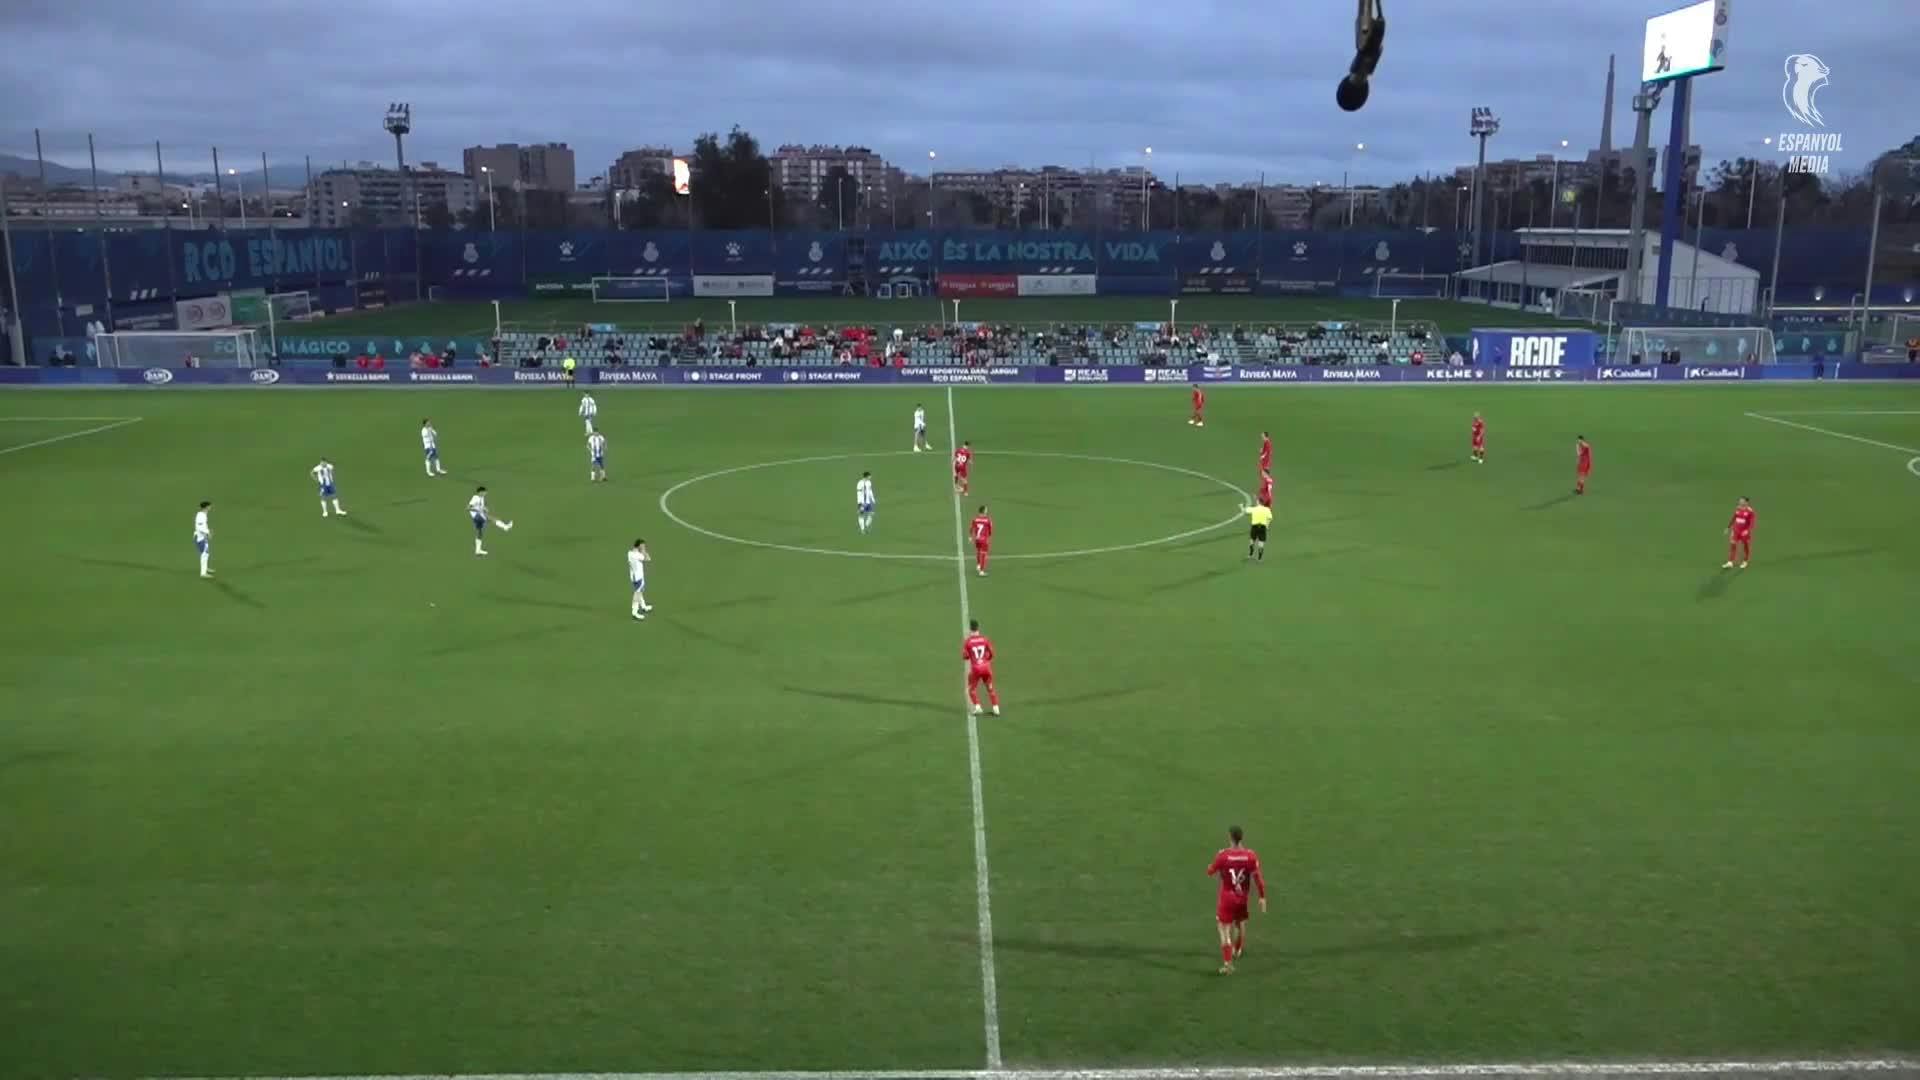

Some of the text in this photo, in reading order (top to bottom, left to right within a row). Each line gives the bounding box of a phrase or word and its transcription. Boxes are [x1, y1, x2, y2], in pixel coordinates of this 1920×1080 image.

[975, 243, 1001, 261] LA
[1008, 241, 1094, 261] NOSTRA
[1106, 242, 1160, 262] VIDA
[183, 237, 350, 282] RCD ESPANYOL
[514, 371, 568, 381] RIVIERA MAY
[600, 371, 658, 381] RIVIERA MAYA
[901, 367, 928, 375] CIUTAT
[929, 367, 969, 375] ESPORTIVA
[1239, 369, 1297, 379] RIVIERA MAYA
[1323, 368, 1381, 379] RIVIERA MAYA
[1426, 369, 1472, 378] KELME
[1506, 369, 1551, 378] KELME
[1613, 368, 1653, 378] CaixaBank
[1701, 368, 1739, 378] CaixaBank
[709, 372, 762, 381] STAGE FRONT
[808, 372, 861, 381] STAGE FRONT
[976, 523, 984, 539] 7
[971, 645, 985, 660] 17
[1228, 867, 1246, 886] 16
